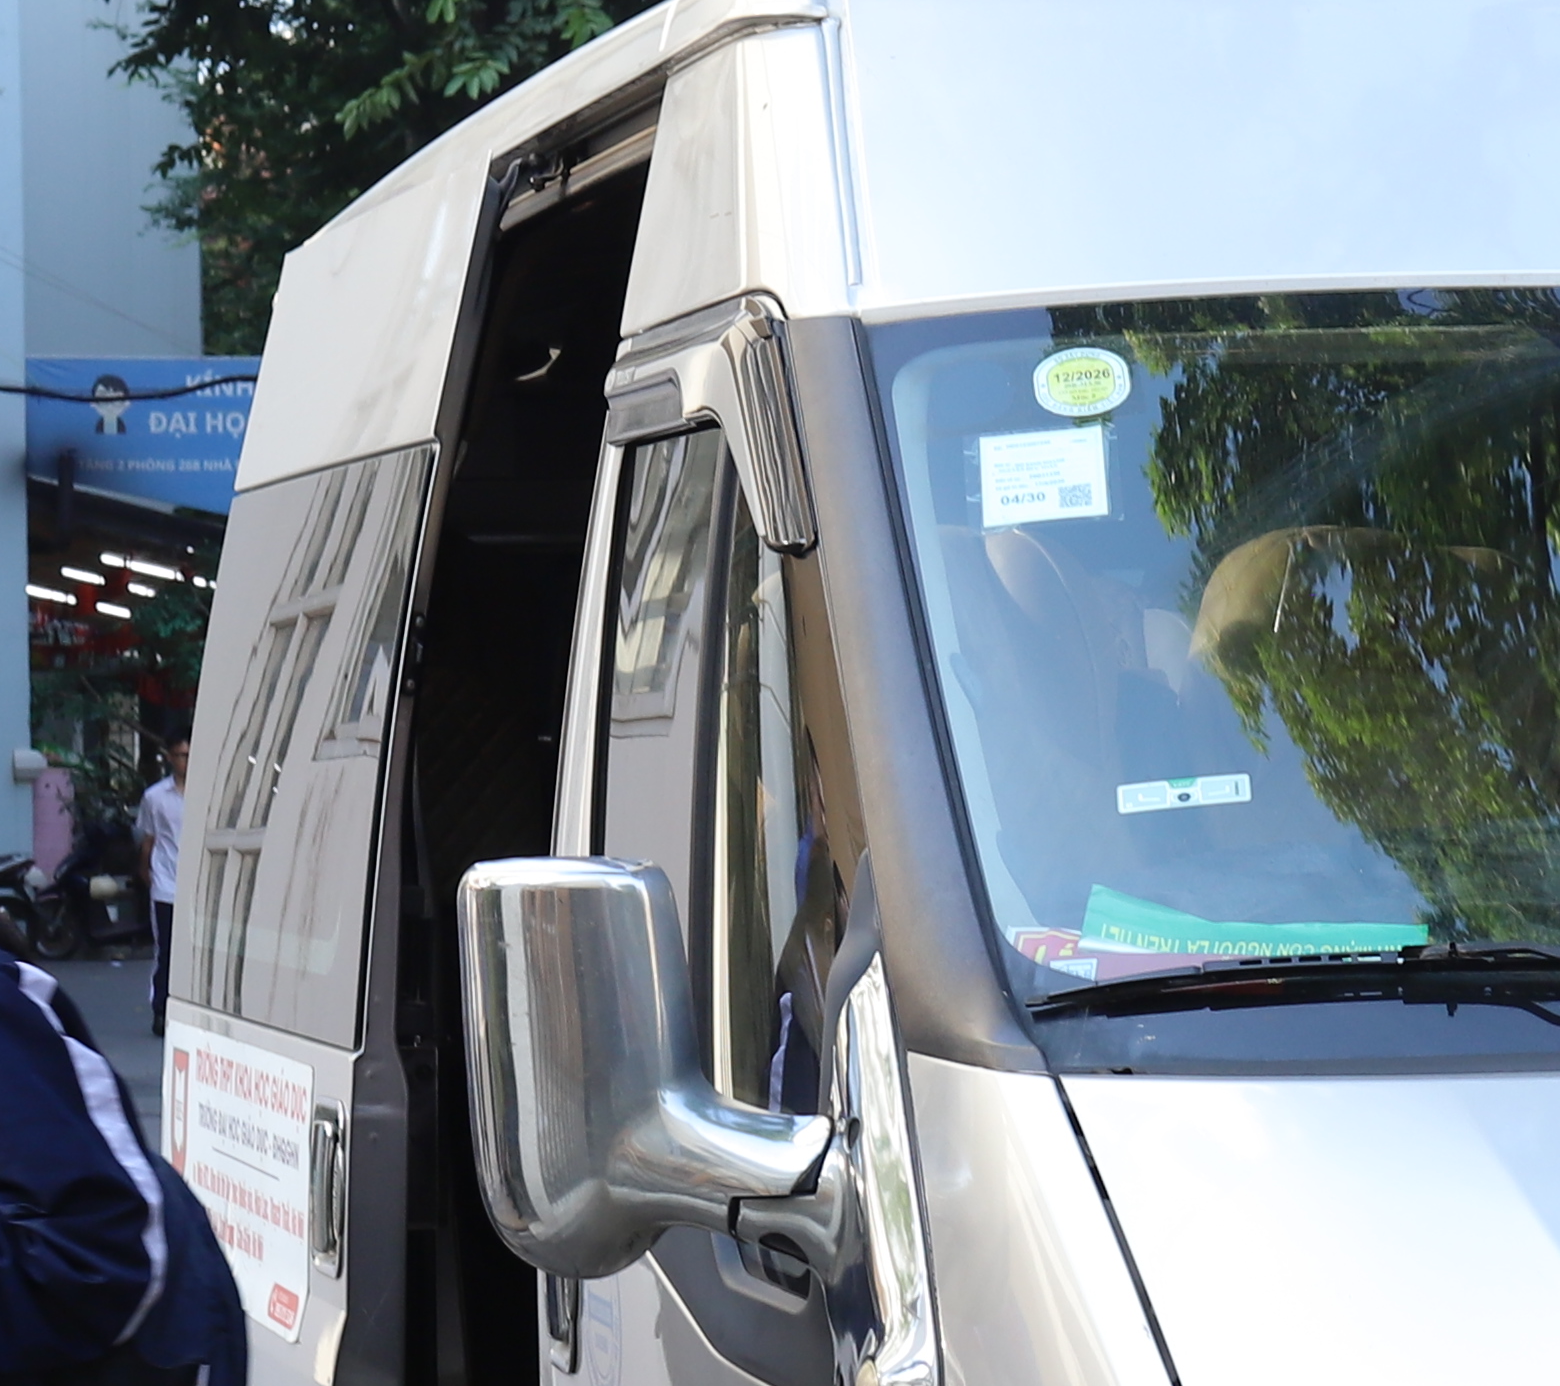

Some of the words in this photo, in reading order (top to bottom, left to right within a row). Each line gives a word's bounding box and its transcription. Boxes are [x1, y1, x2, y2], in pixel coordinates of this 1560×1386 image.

[1054, 368, 1111, 384] 12/2026
[148, 411, 197, 438] ĐẠI
[1000, 492, 1046, 506] 04/30
